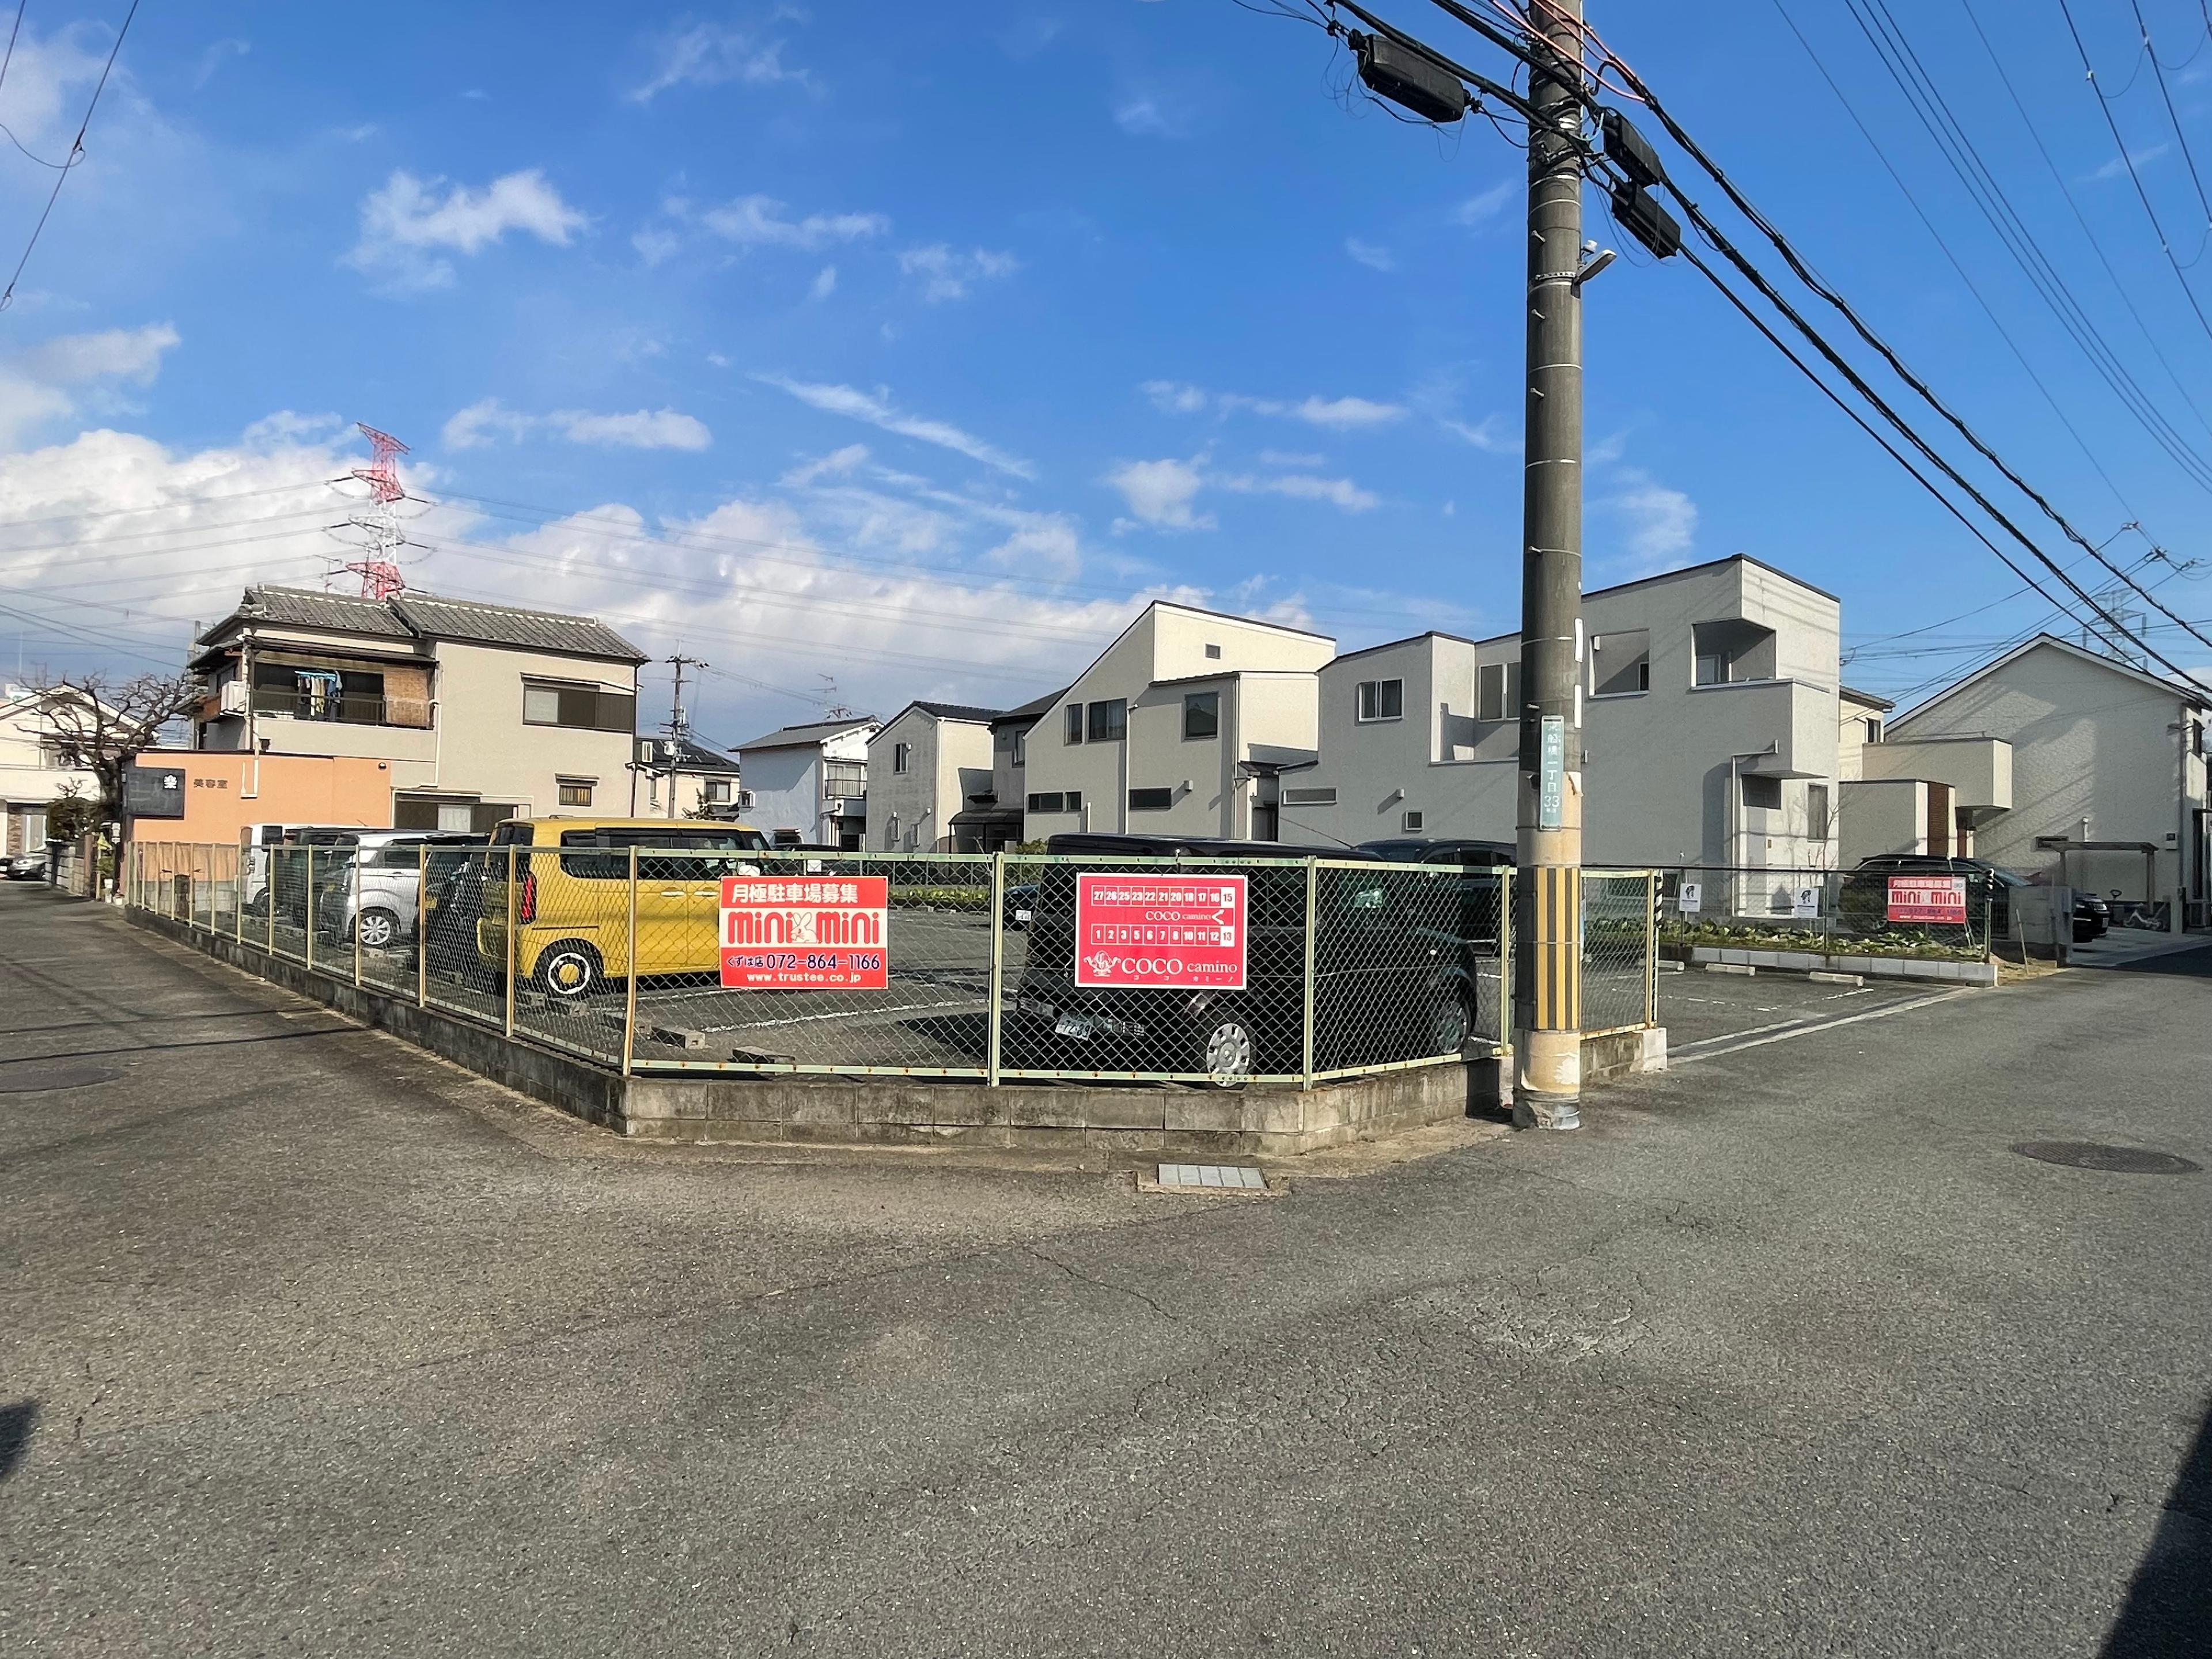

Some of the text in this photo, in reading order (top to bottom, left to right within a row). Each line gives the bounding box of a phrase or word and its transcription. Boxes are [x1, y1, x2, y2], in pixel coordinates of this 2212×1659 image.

[1544, 796, 1559, 808] 33
[732, 882, 858, 904] 月極駐車場募集
[1094, 891, 1104, 900] 27
[1119, 891, 1130, 901] 25
[1132, 892, 1142, 901] 23
[1145, 892, 1156, 902] 22
[1159, 892, 1168, 902] 21
[1171, 892, 1181, 902] 20
[1184, 892, 1194, 902] 18
[1198, 892, 1207, 902] 17
[1210, 893, 1220, 903] 16
[1223, 893, 1232, 902] 15
[1145, 911, 1180, 921] COCO
[728, 912, 879, 944] mini mini
[1096, 930, 1232, 941] 1 2 3 5 6 7 8 10 11 12 13
[727, 954, 881, 969] くずは店 072-864-1166
[1121, 958, 1183, 974] COCO
[1187, 960, 1237, 973] camino
[747, 972, 861, 983] www.trustee.co.jp
